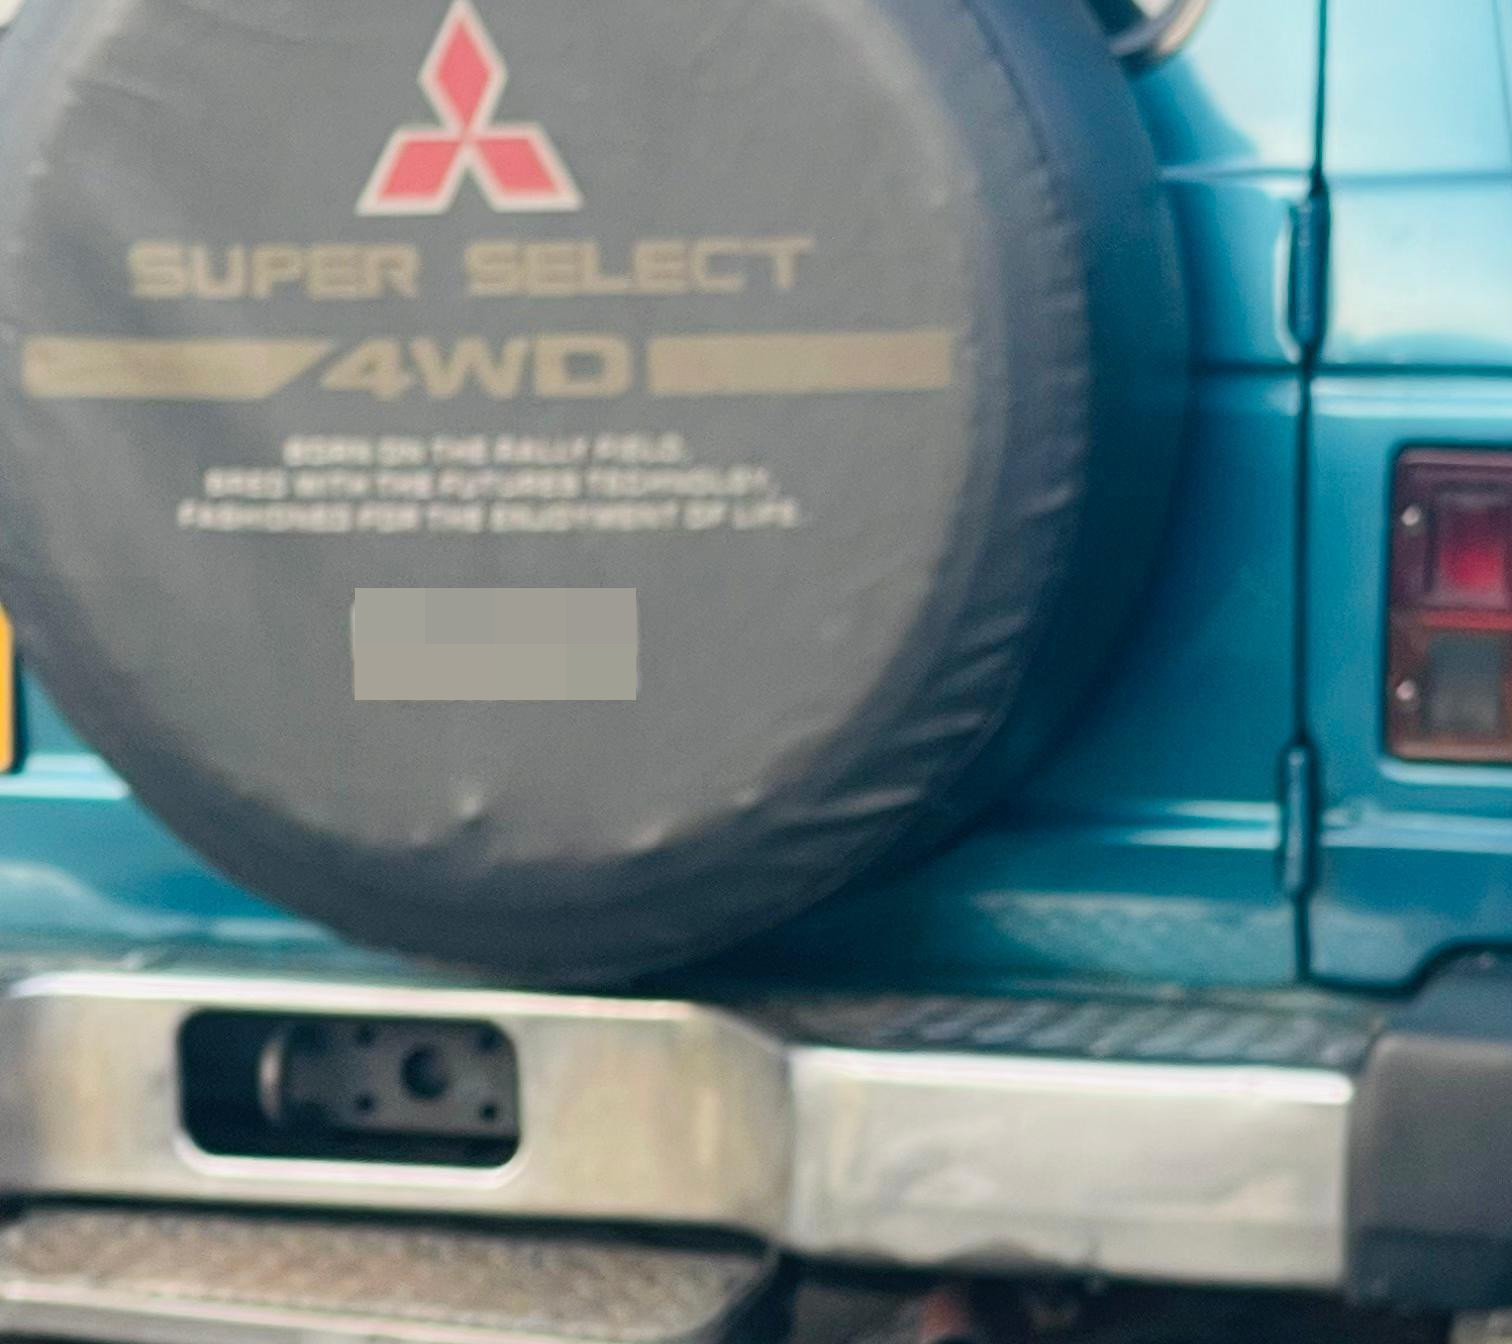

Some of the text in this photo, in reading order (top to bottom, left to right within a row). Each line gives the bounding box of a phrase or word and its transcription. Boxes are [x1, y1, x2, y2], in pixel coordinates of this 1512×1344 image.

[129, 237, 814, 299] SUPER SELECT
[319, 336, 632, 400] 4WD
[431, 435, 486, 465] THE
[375, 467, 432, 497] THE
[356, 501, 418, 533] FOR
[425, 501, 483, 532] THE
